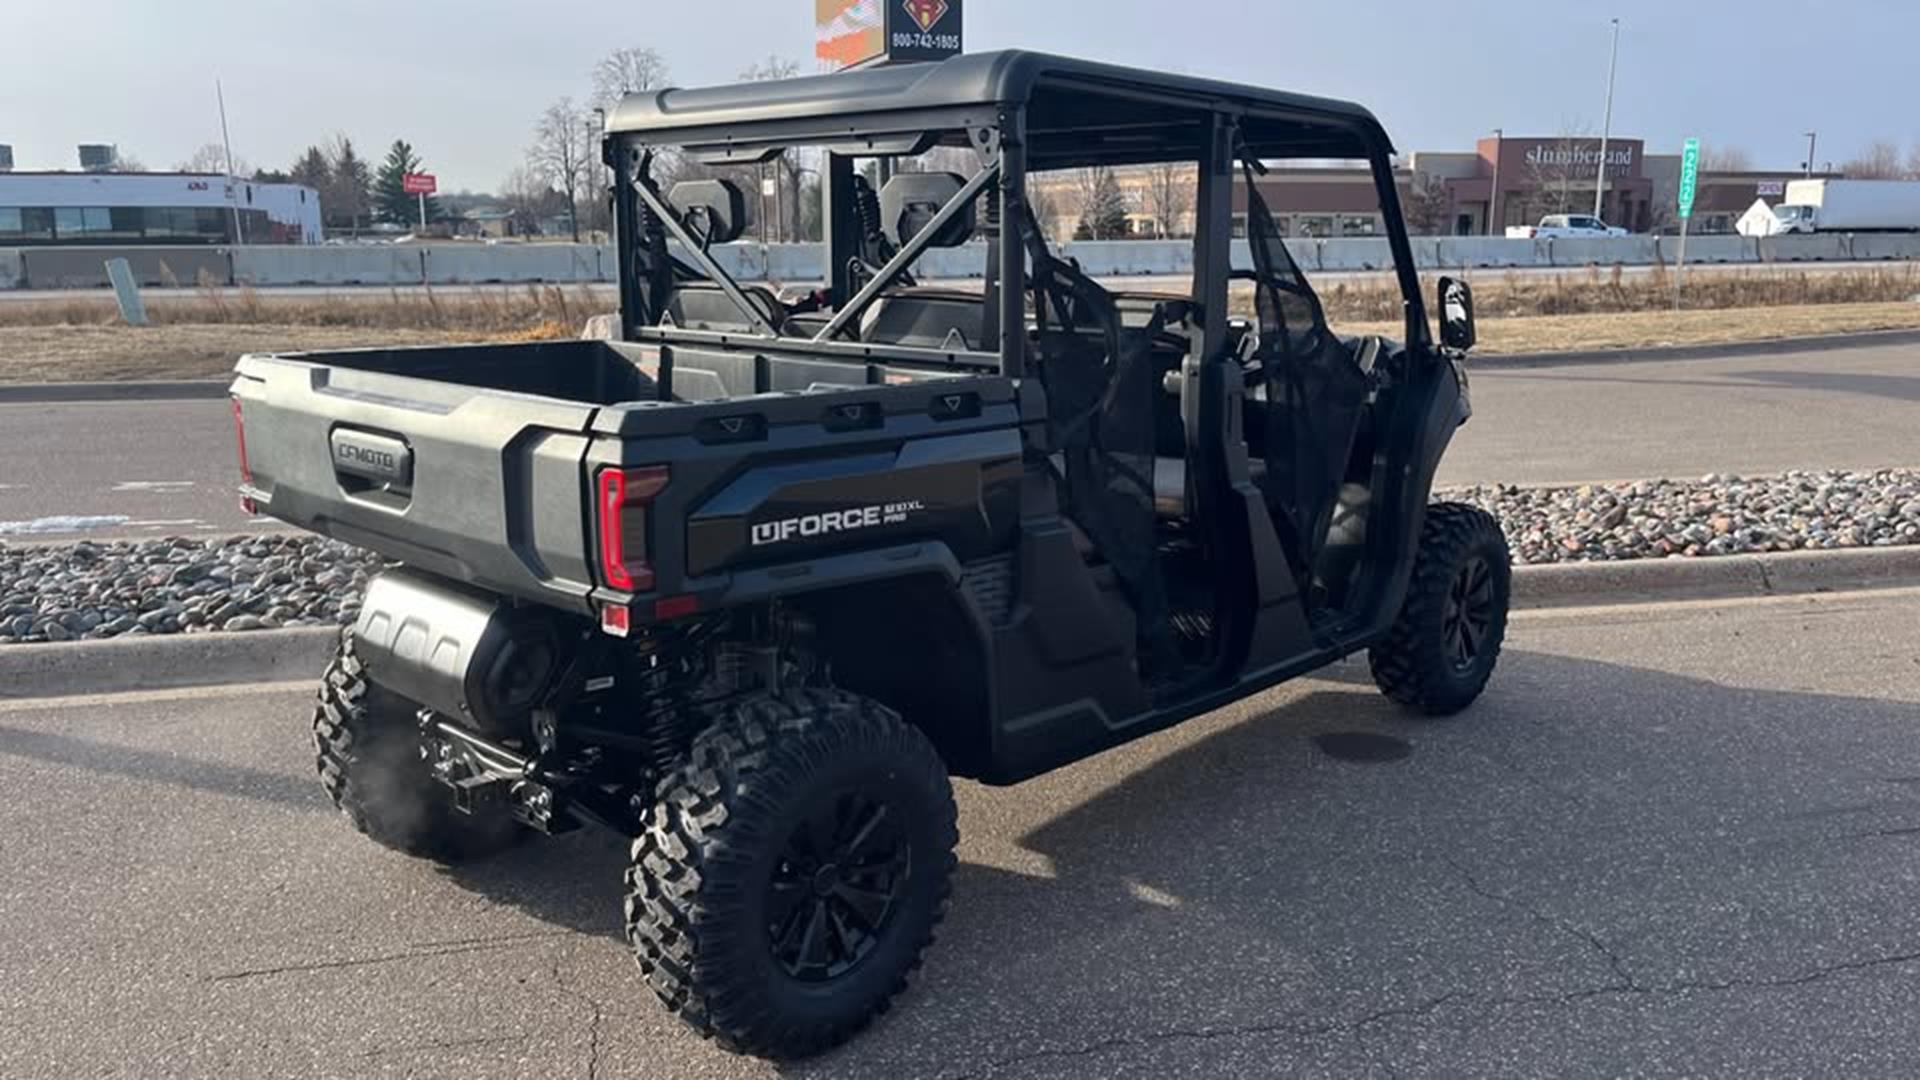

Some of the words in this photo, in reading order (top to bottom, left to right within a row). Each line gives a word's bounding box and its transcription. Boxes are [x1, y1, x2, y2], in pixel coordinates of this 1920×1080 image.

[892, 32, 960, 49] 800-742-1805
[1525, 145, 1633, 165] slumberand
[339, 443, 394, 468] CFMOTO
[751, 505, 882, 546] UFORCE
[883, 512, 907, 524] PRO
